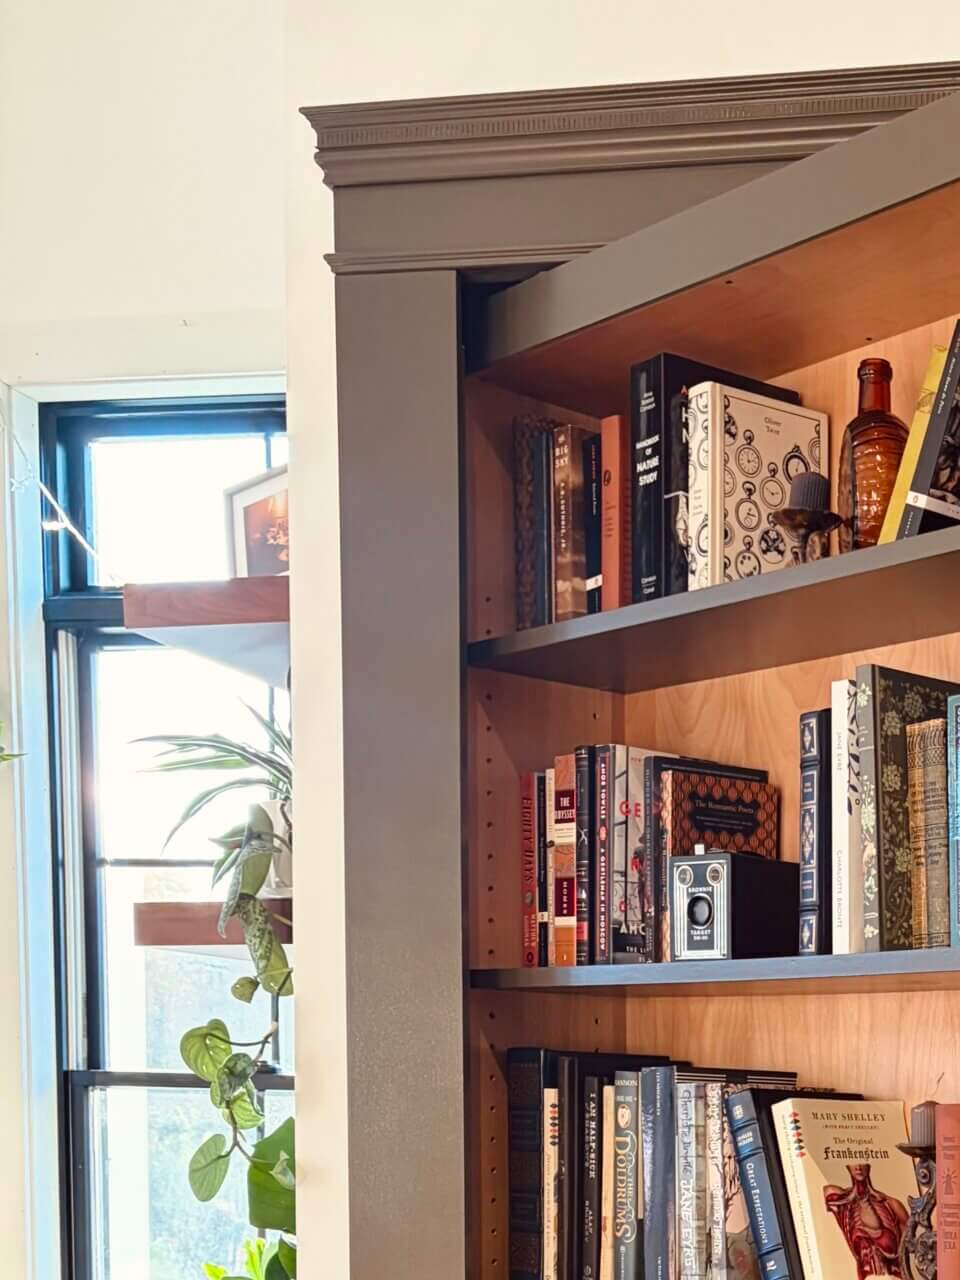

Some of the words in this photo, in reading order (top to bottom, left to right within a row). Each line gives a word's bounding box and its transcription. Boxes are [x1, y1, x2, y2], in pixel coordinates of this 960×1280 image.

[554, 445, 569, 457] BIG
[554, 457, 569, 469] SKY
[636, 456, 660, 474] NATURE
[638, 470, 659, 487] STUDY
[559, 797, 570, 807] THE
[522, 849, 534, 883] DAYS
[811, 1111, 838, 1121] MARY
[841, 1112, 886, 1122] SHELLEY
[833, 1136, 846, 1145] The
[847, 1136, 874, 1146] Original
[823, 1146, 890, 1161] Frankenstein
[745, 1162, 757, 1187] GREAT
[614, 1134, 632, 1239] DOLDRUMS
[680, 1178, 695, 1224] JANE
[750, 1187, 768, 1245] EXPECTATIONS
[683, 1227, 696, 1272] EYRE
